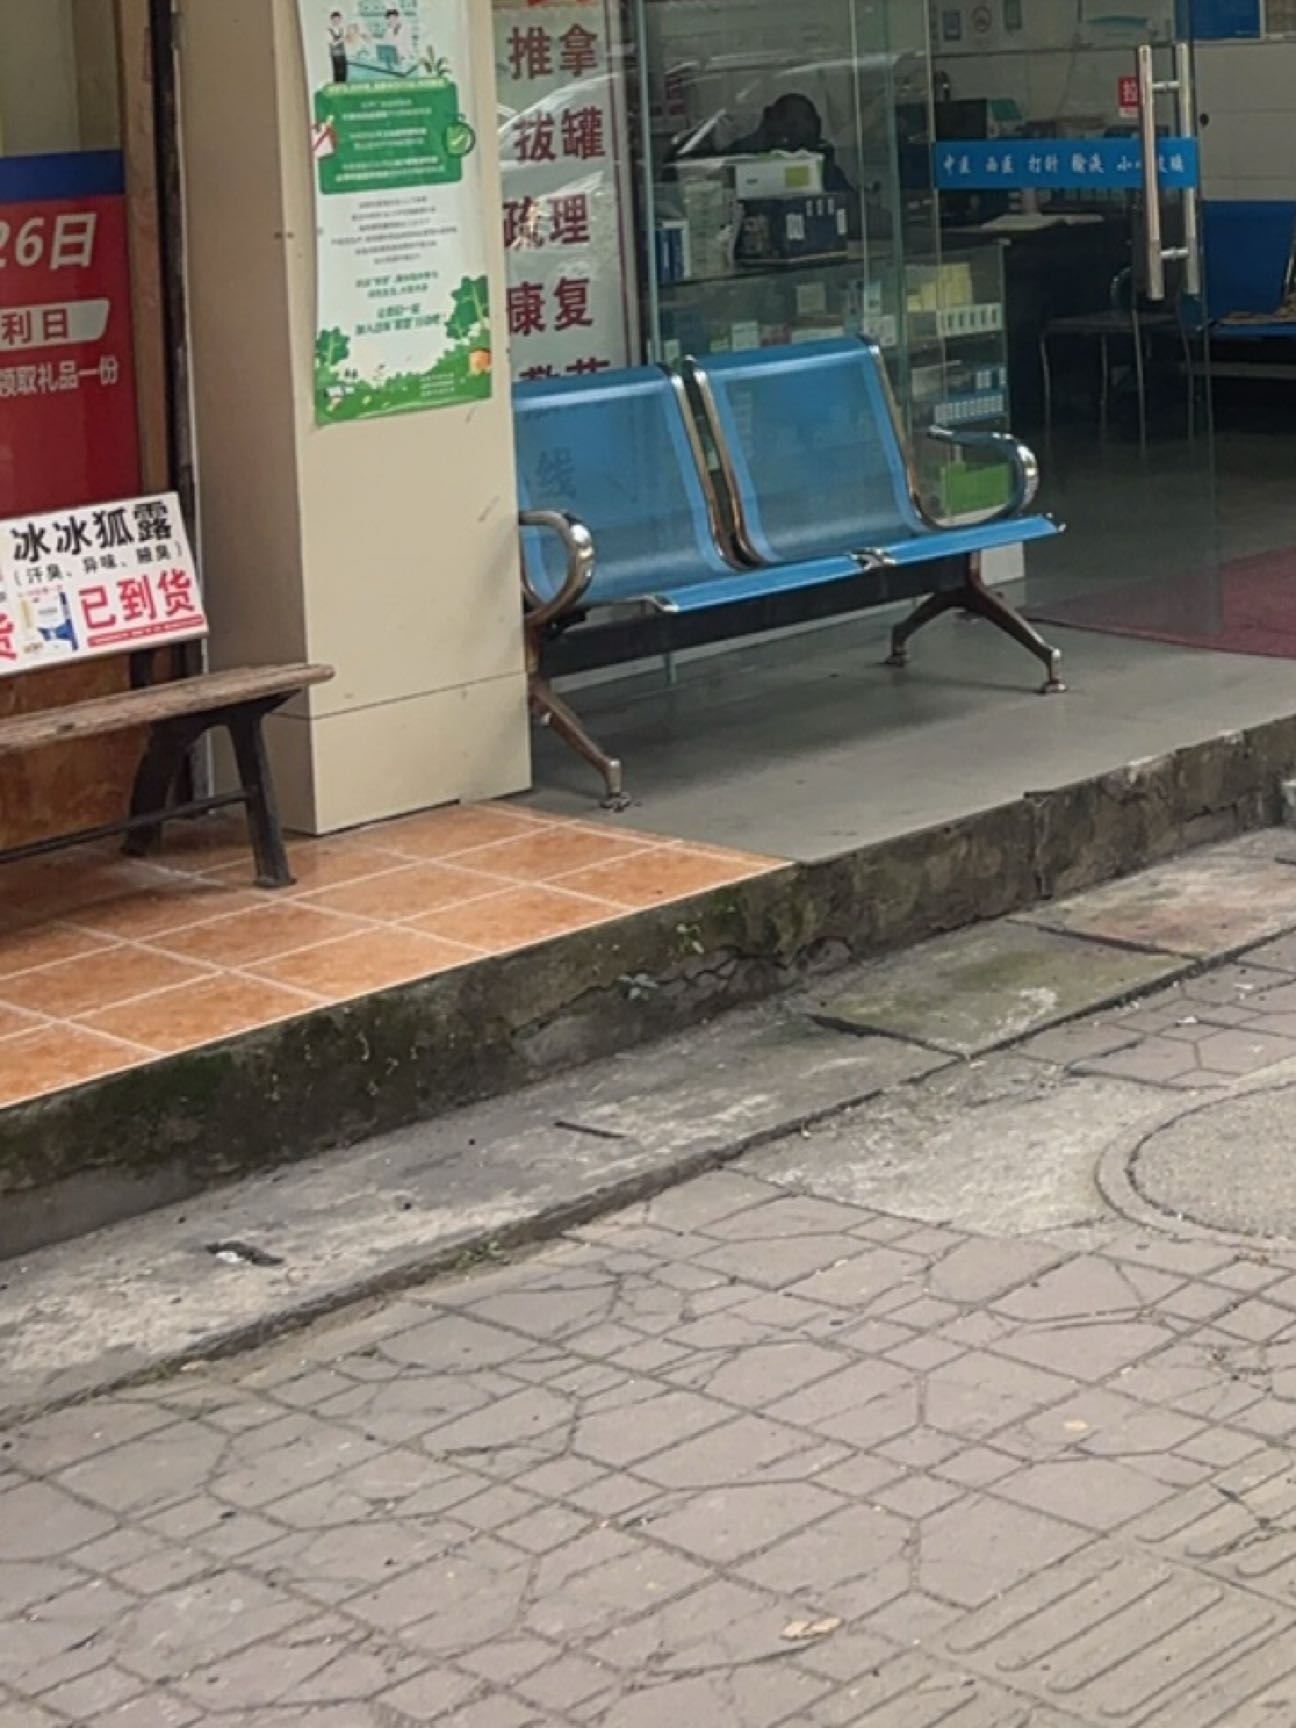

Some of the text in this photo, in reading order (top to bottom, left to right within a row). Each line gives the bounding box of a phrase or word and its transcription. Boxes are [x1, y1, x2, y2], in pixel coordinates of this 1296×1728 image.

[508, 23, 599, 81] 推拿
[513, 106, 606, 161] 拔罐
[506, 275, 596, 337] 康复
[10, 500, 173, 563] 冰冰狐露
[78, 569, 195, 630] 已到货
